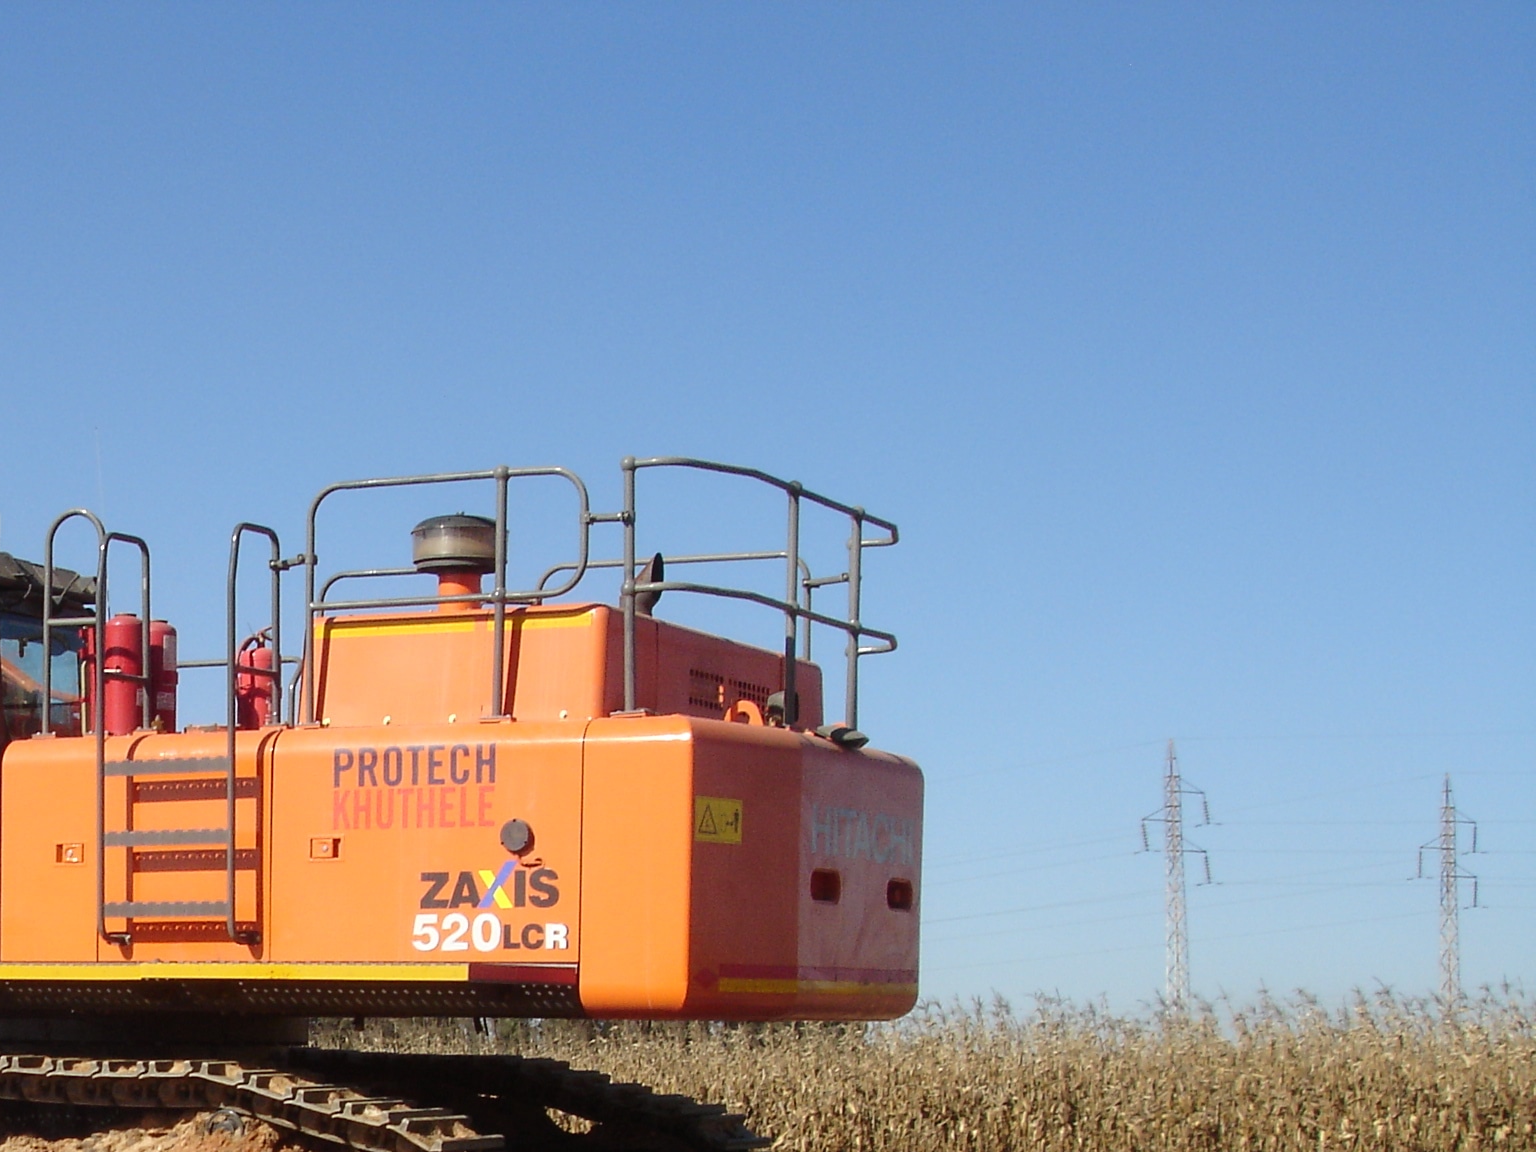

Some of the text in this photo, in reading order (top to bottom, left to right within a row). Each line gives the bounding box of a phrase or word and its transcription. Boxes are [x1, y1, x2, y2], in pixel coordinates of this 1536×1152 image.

[333, 743, 497, 788] PROTECH
[332, 785, 496, 830] KHUTHELE
[812, 801, 914, 867] HITACHI
[420, 860, 560, 909] ZAXIS
